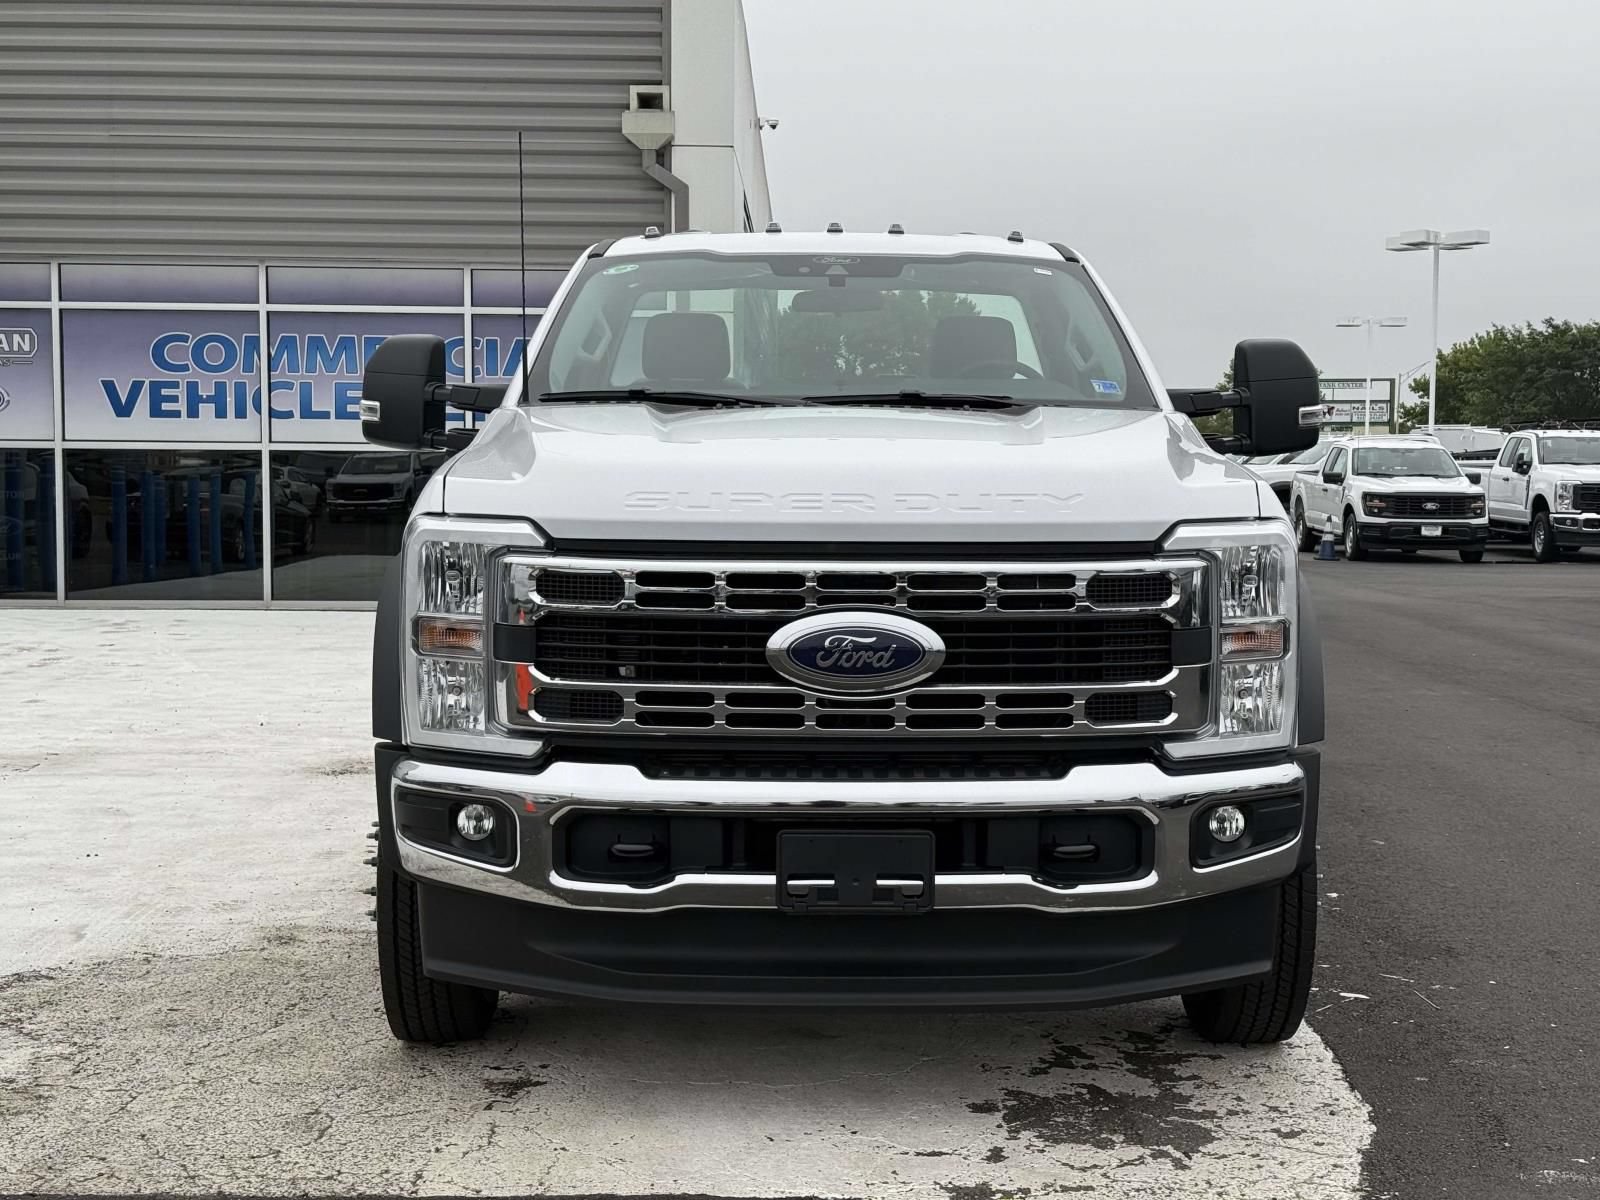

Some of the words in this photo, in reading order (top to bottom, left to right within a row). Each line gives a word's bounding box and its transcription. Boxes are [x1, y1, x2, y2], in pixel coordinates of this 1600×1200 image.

[100, 379, 366, 421] VEHICLE
[623, 491, 877, 513] SUPER
[893, 493, 1084, 513] DUTY
[815, 635, 897, 669] Ford
